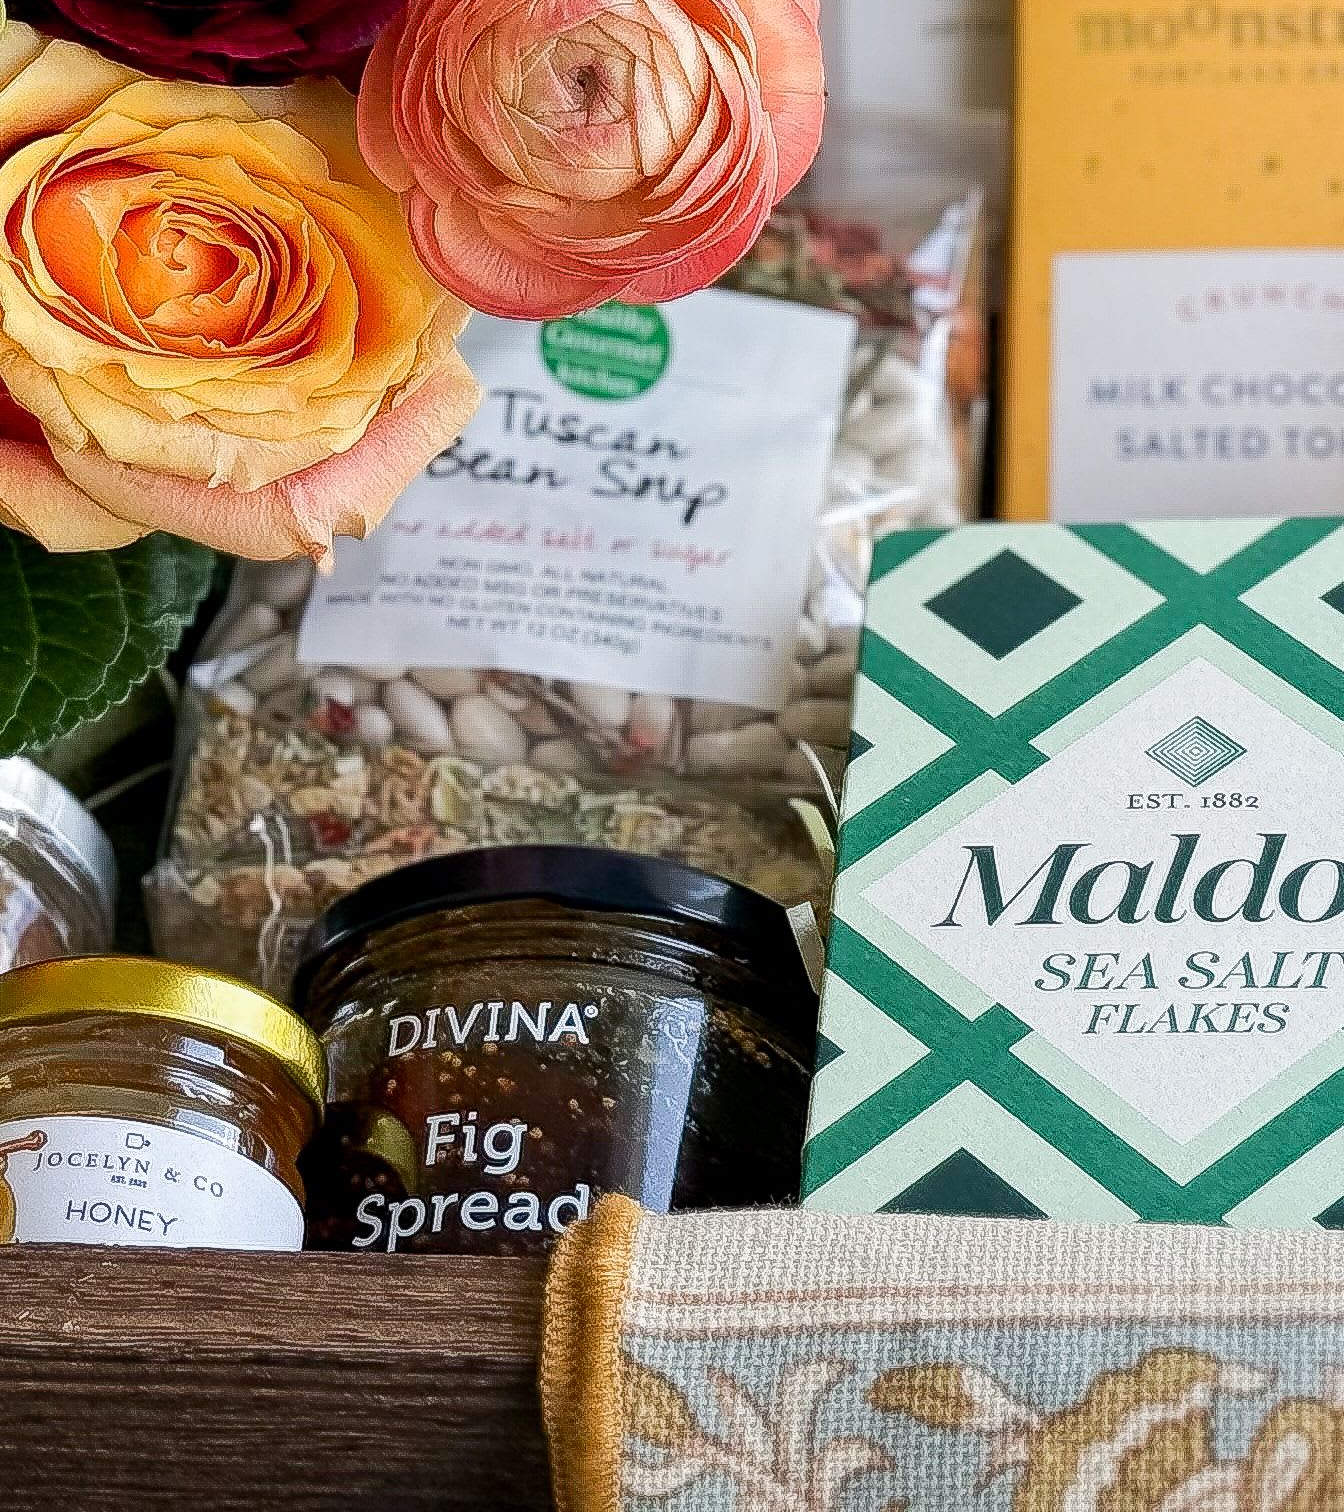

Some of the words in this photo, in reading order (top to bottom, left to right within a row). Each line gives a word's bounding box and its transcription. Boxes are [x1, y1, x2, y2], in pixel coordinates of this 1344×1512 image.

[1089, 375, 1187, 407] MILK
[490, 388, 688, 460] Tuscan
[1115, 426, 1270, 462] SALTED
[1126, 793, 1190, 811] EST.
[1201, 793, 1260, 811] 1882
[1034, 951, 1157, 992] SEA
[1082, 1001, 1291, 1036] FLAKES
[424, 1110, 529, 1175] Fig
[32, 1151, 151, 1176] JOCELYN
[164, 1167, 181, 1184] &
[193, 1175, 224, 1198] CO
[65, 1199, 179, 1237] HONEY
[351, 1183, 591, 1253] Spread
